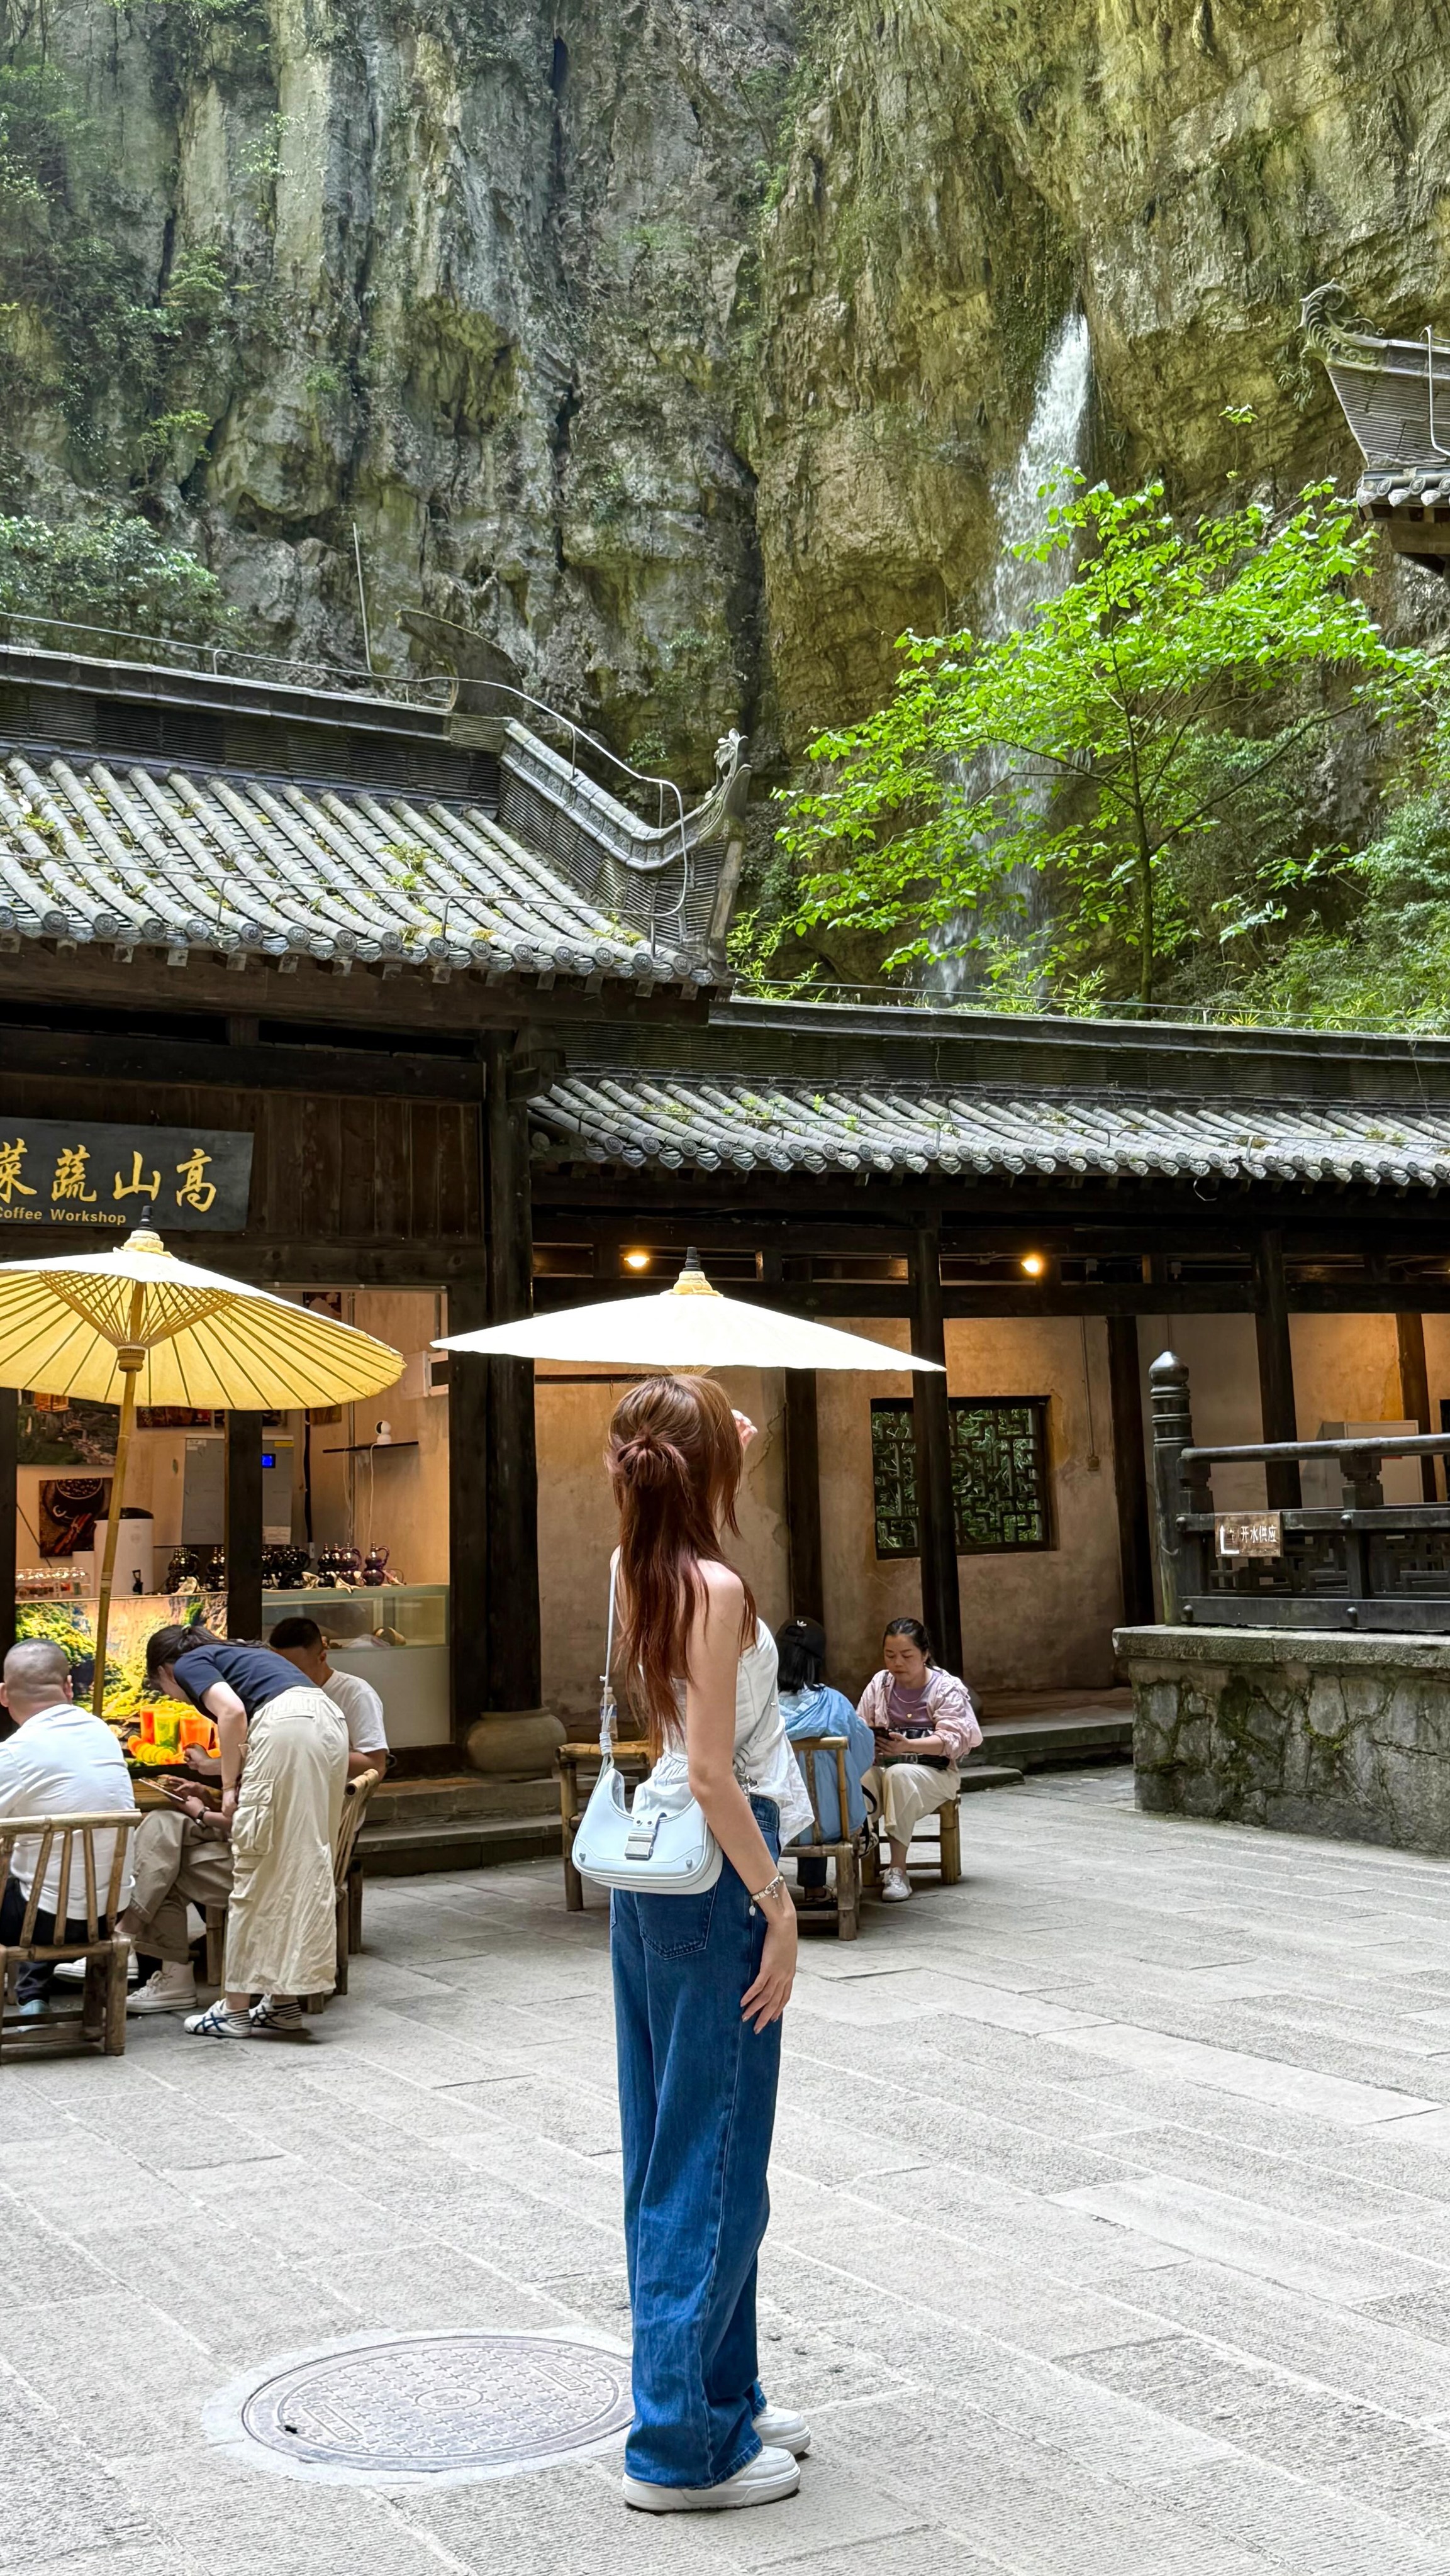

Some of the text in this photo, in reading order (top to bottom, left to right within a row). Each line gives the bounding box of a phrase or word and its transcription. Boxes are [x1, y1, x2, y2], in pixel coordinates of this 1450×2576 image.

[50, 1208, 126, 1225] Workshop
[1241, 1524, 1278, 1543] 开水供应
